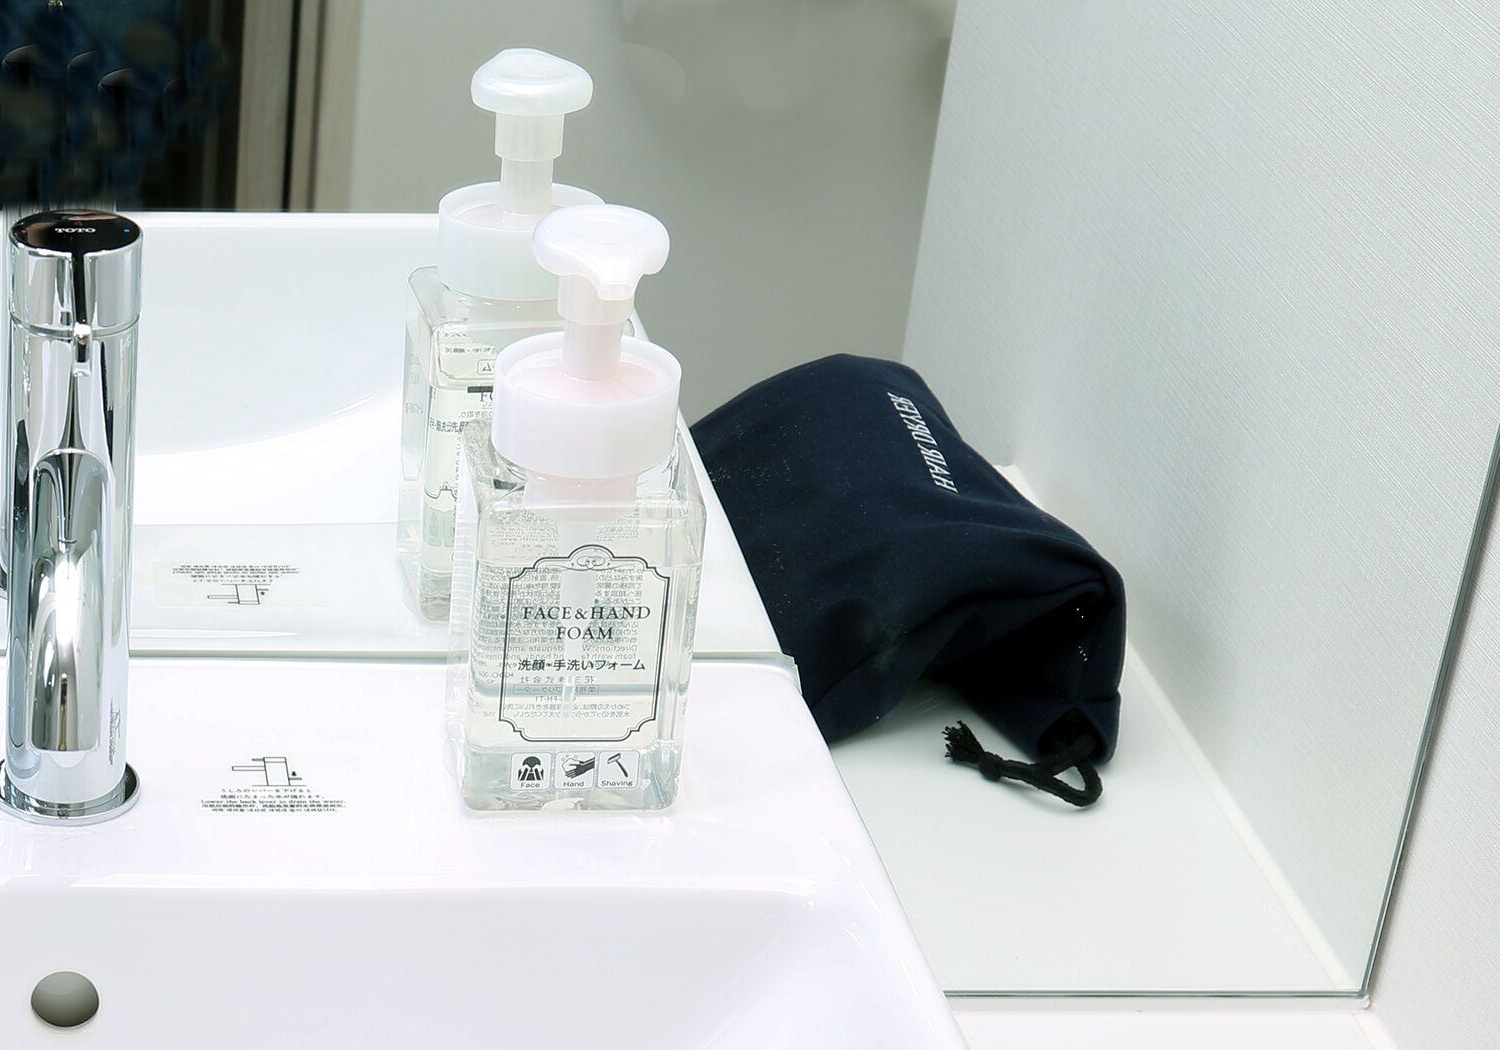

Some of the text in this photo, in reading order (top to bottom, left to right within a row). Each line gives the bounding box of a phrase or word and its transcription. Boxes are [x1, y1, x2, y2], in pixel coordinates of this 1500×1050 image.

[557, 625, 613, 640] FOAM
[520, 781, 541, 789] Face
[601, 780, 634, 788] Shaving
